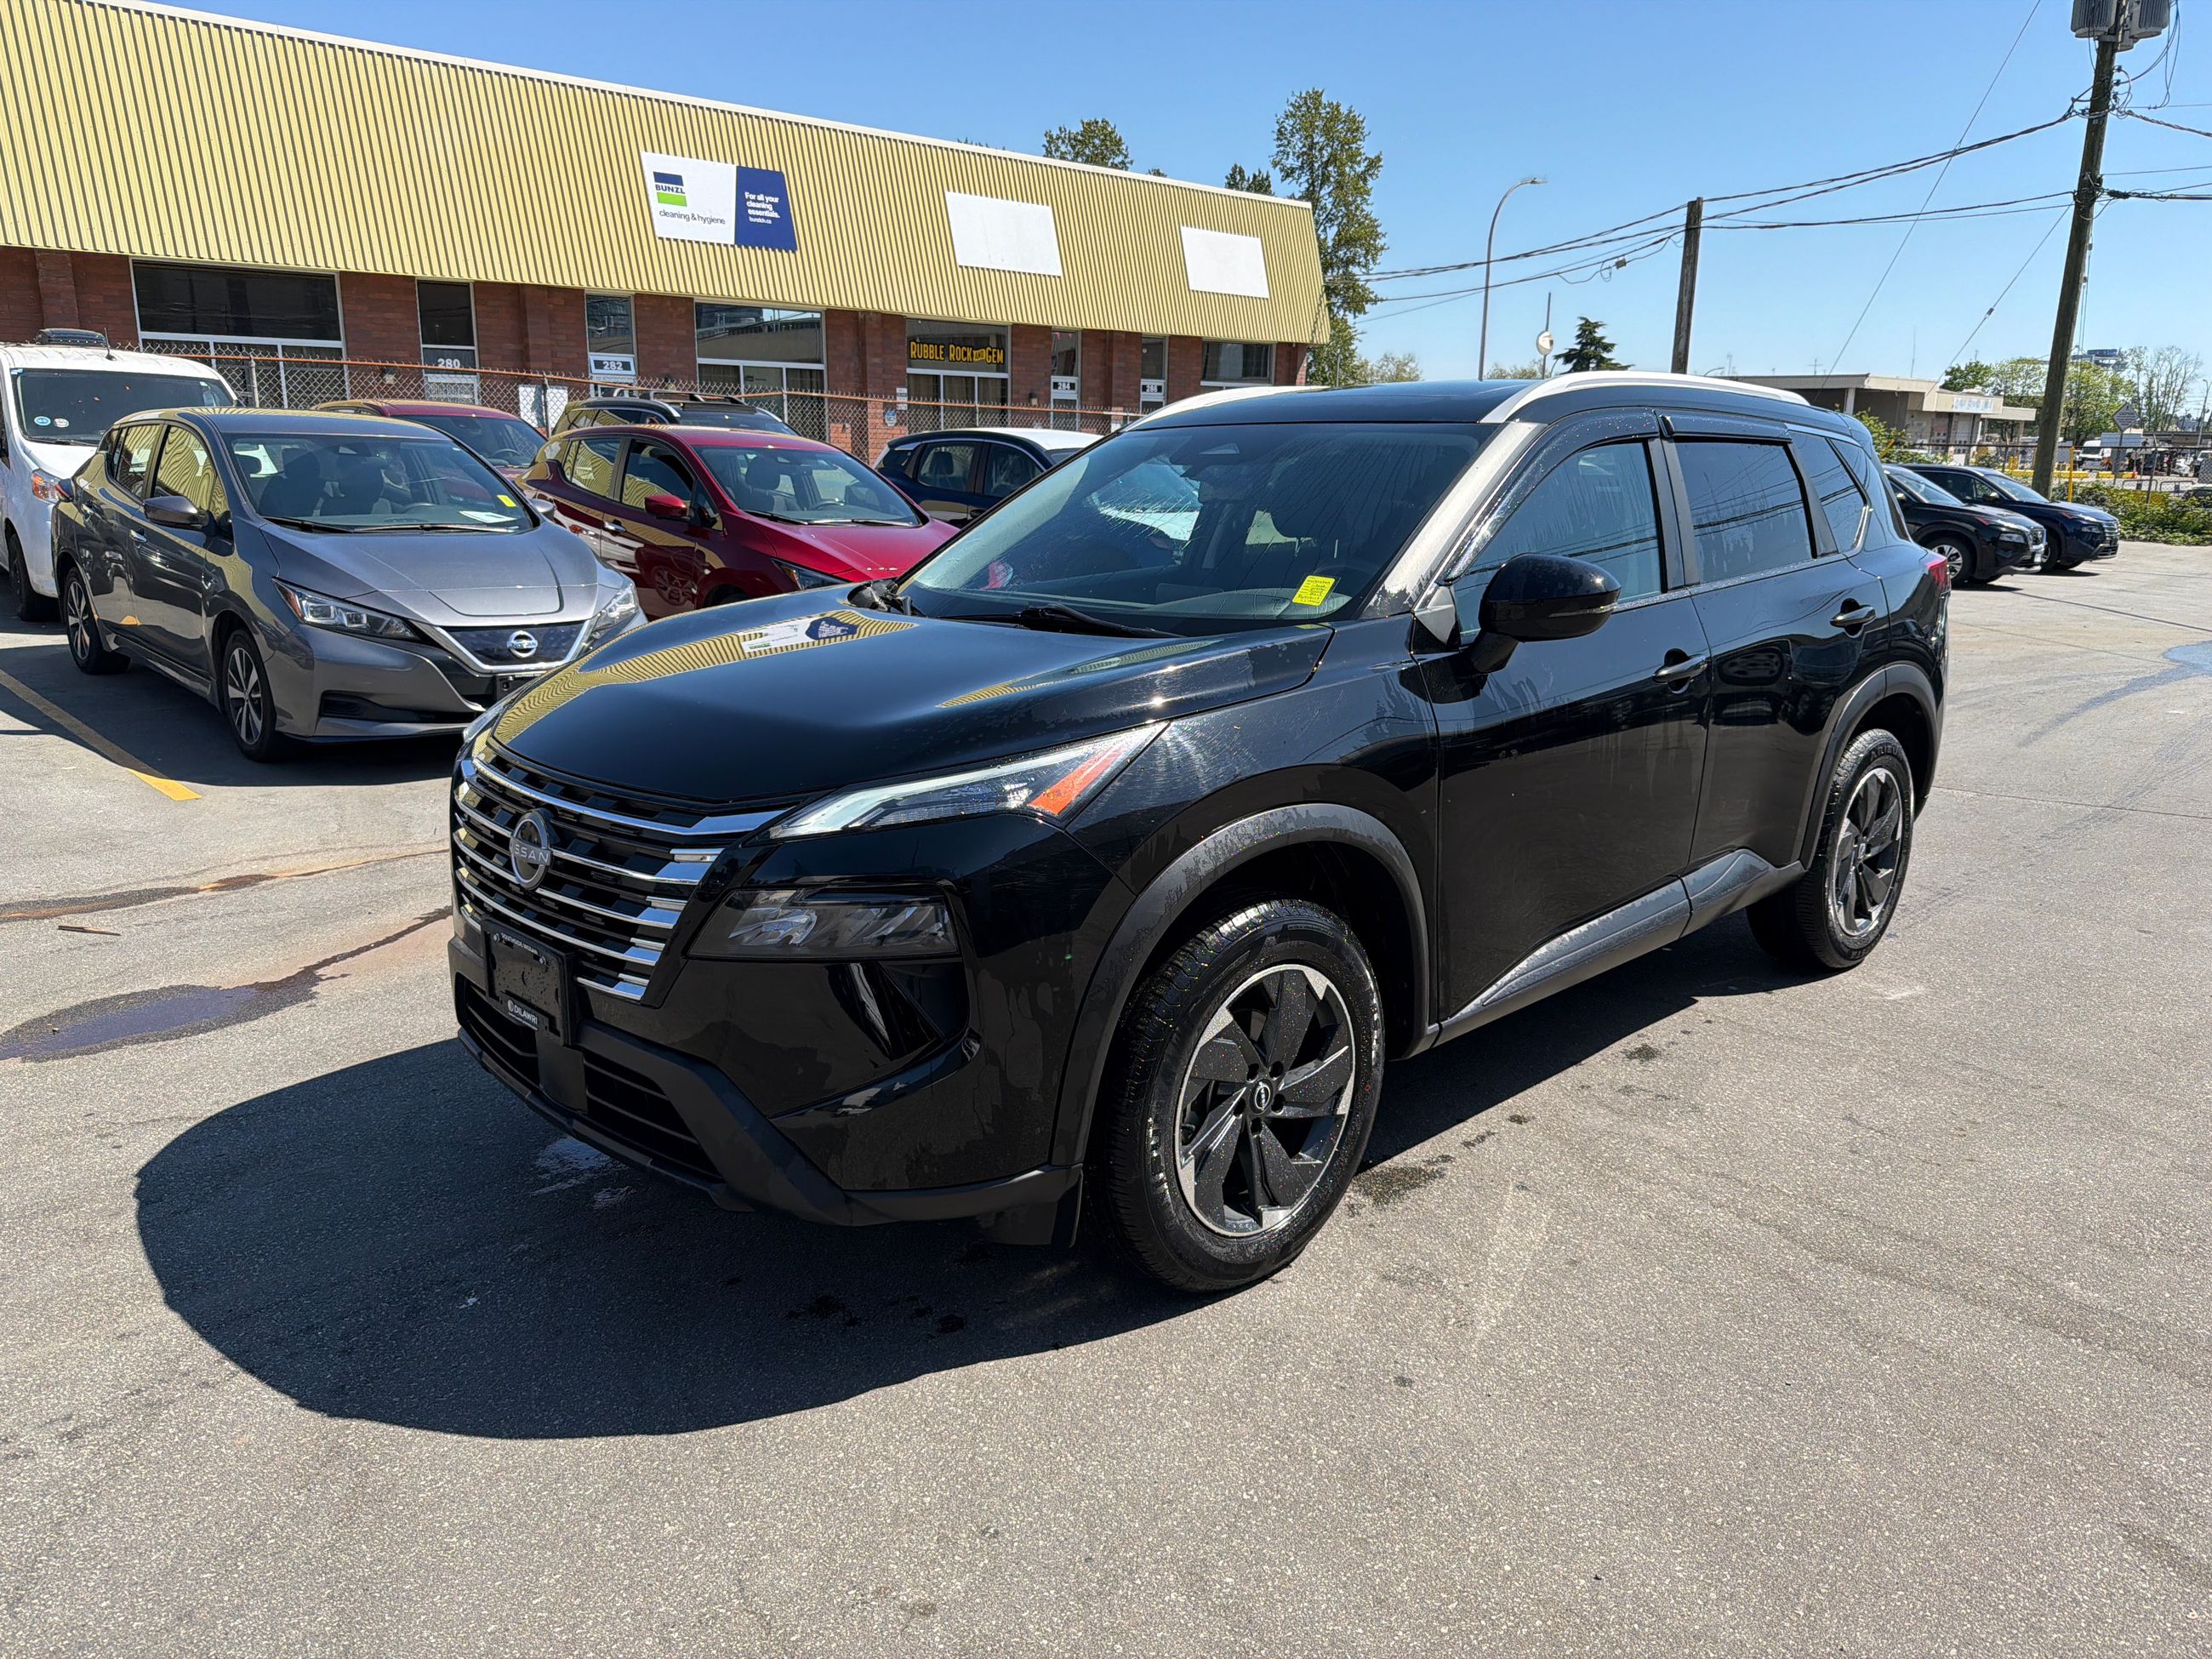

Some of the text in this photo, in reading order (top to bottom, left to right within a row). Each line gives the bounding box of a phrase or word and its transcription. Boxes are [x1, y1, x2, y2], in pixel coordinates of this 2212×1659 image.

[655, 184, 686, 194] BUNZL
[744, 191, 756, 200] For
[765, 195, 779, 203] your
[746, 200, 773, 211] cleaning
[658, 208, 726, 225] cleaning & hygiene
[747, 208, 781, 219] essentials.
[910, 341, 945, 361] RUBBLE
[949, 344, 973, 362] ROCK
[986, 346, 1004, 363] GEM
[437, 357, 461, 368] 280
[602, 361, 623, 371] 282
[1058, 382, 1071, 391] 284
[510, 841, 549, 864] ISSAN
[514, 1005, 539, 1025] DILAWRI
